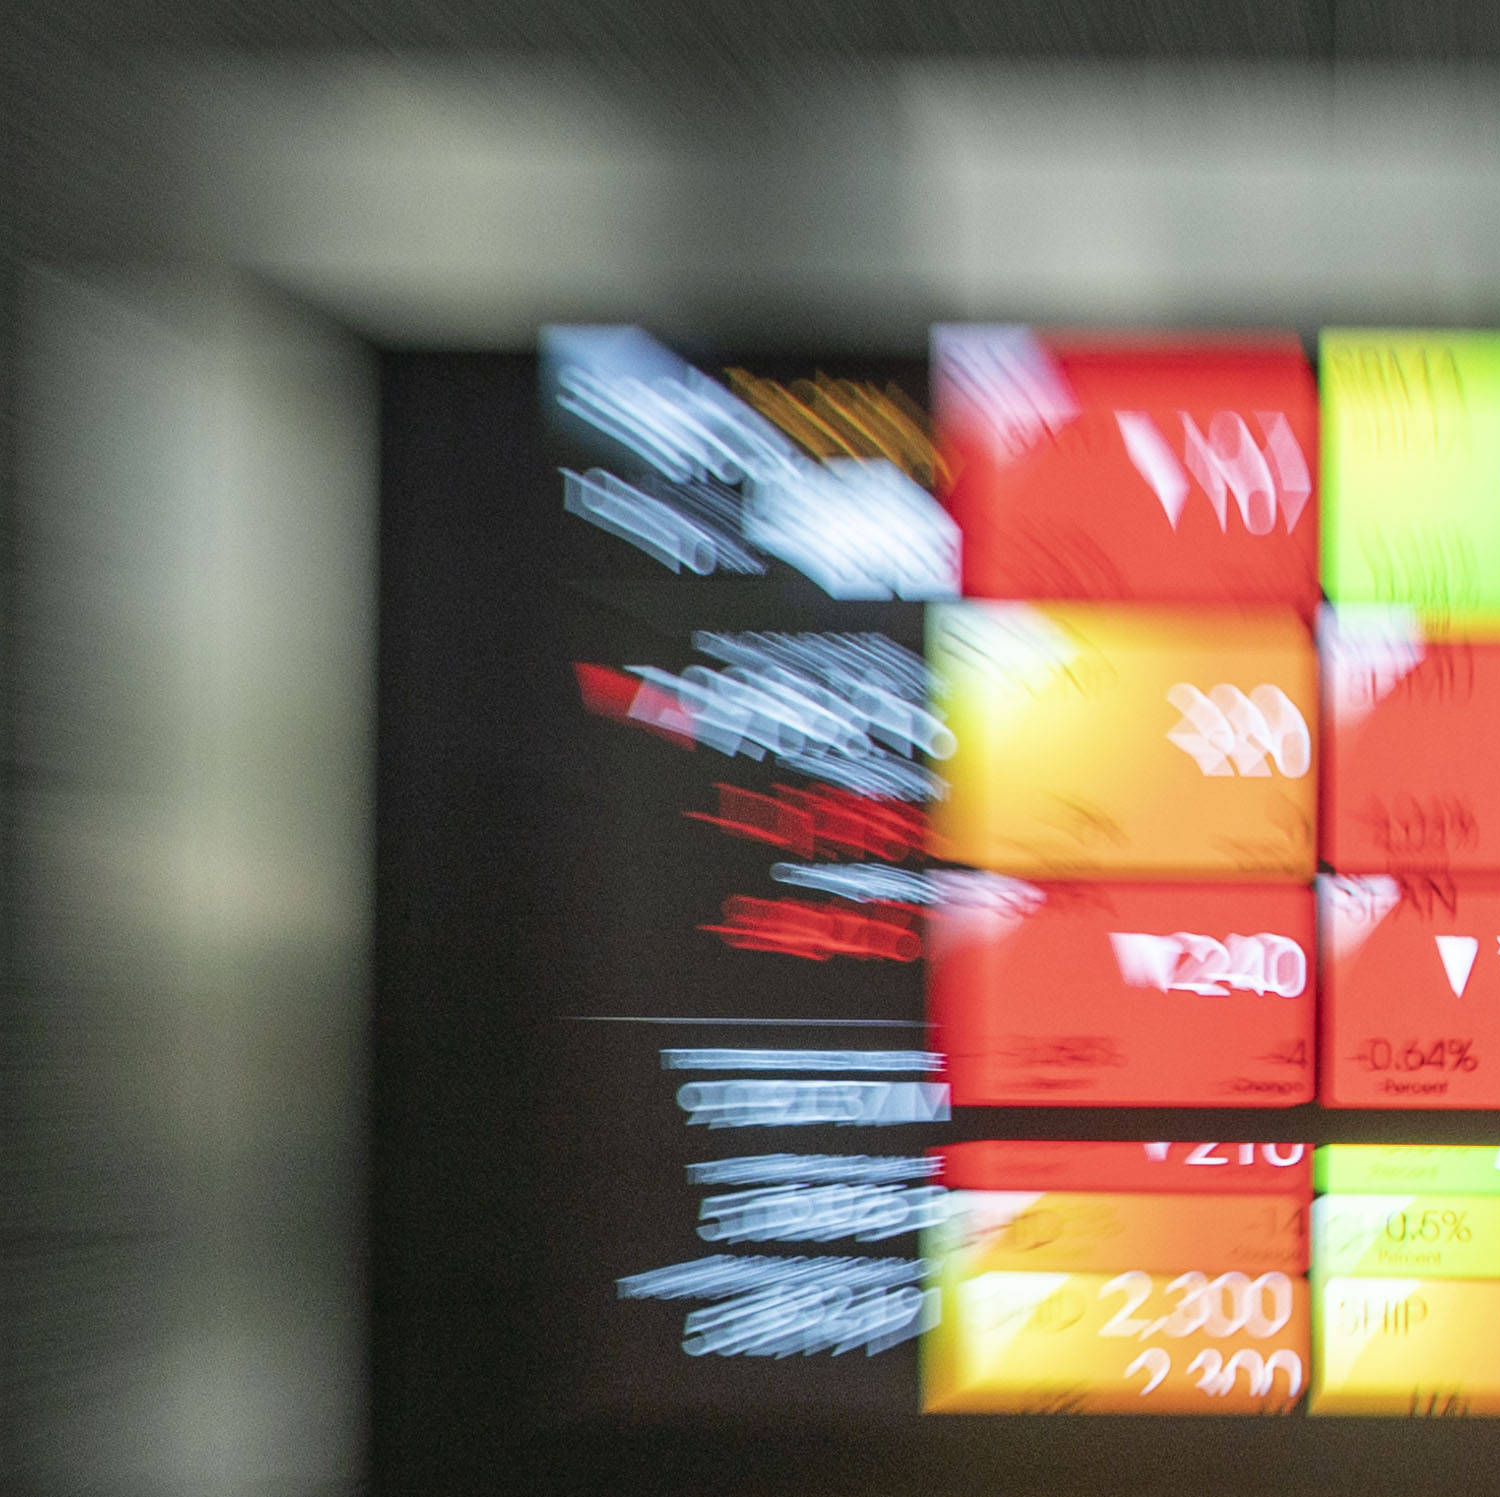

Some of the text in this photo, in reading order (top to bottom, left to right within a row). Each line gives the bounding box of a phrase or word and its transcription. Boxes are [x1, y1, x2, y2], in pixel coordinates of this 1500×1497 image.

[1348, 1037, 1479, 1073] -0.64%
[1383, 1209, 1473, 1244] 0.5%
[1097, 1270, 1293, 1343] 2,300
